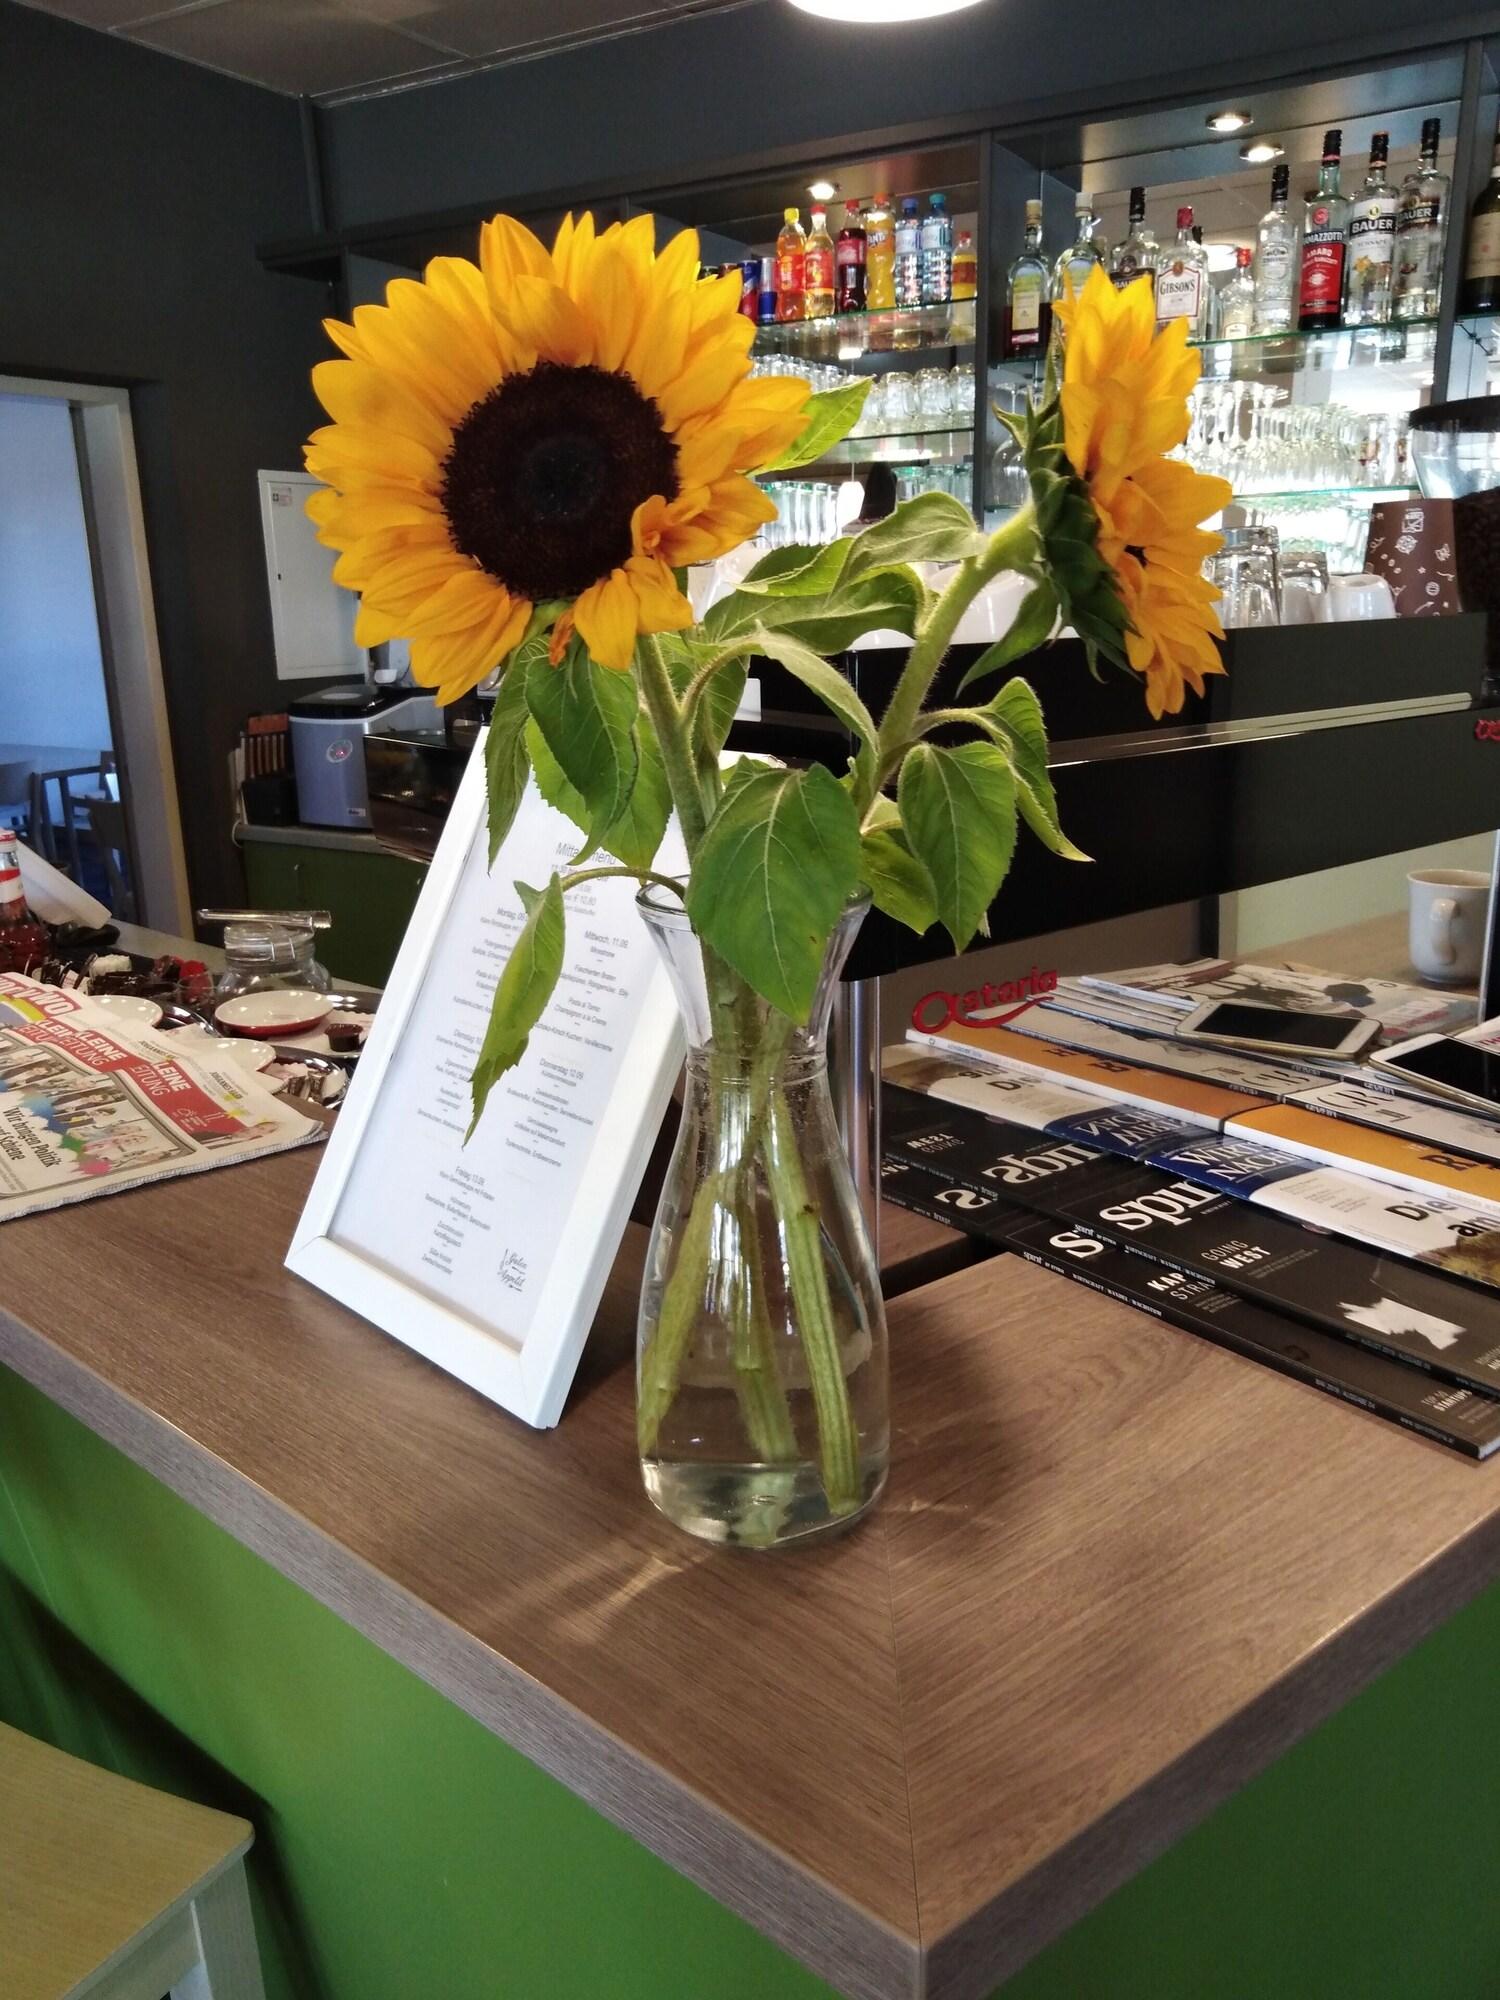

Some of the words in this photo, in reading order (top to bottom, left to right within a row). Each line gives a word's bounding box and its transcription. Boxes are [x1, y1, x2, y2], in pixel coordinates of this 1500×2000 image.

[1352, 219, 1393, 233] BAUER
[1160, 278, 1196, 296] GIBSON'S
[3, 1106, 25, 1123] Wir
[12, 1121, 42, 1146] bringen
[30, 1142, 62, 1168] Politik
[1206, 1150, 1299, 1182] NACH
[1099, 1179, 1222, 1231] spir
[1384, 1200, 1459, 1221] Die
[1200, 1240, 1248, 1262] GOING
[1219, 1246, 1271, 1269] WEST
